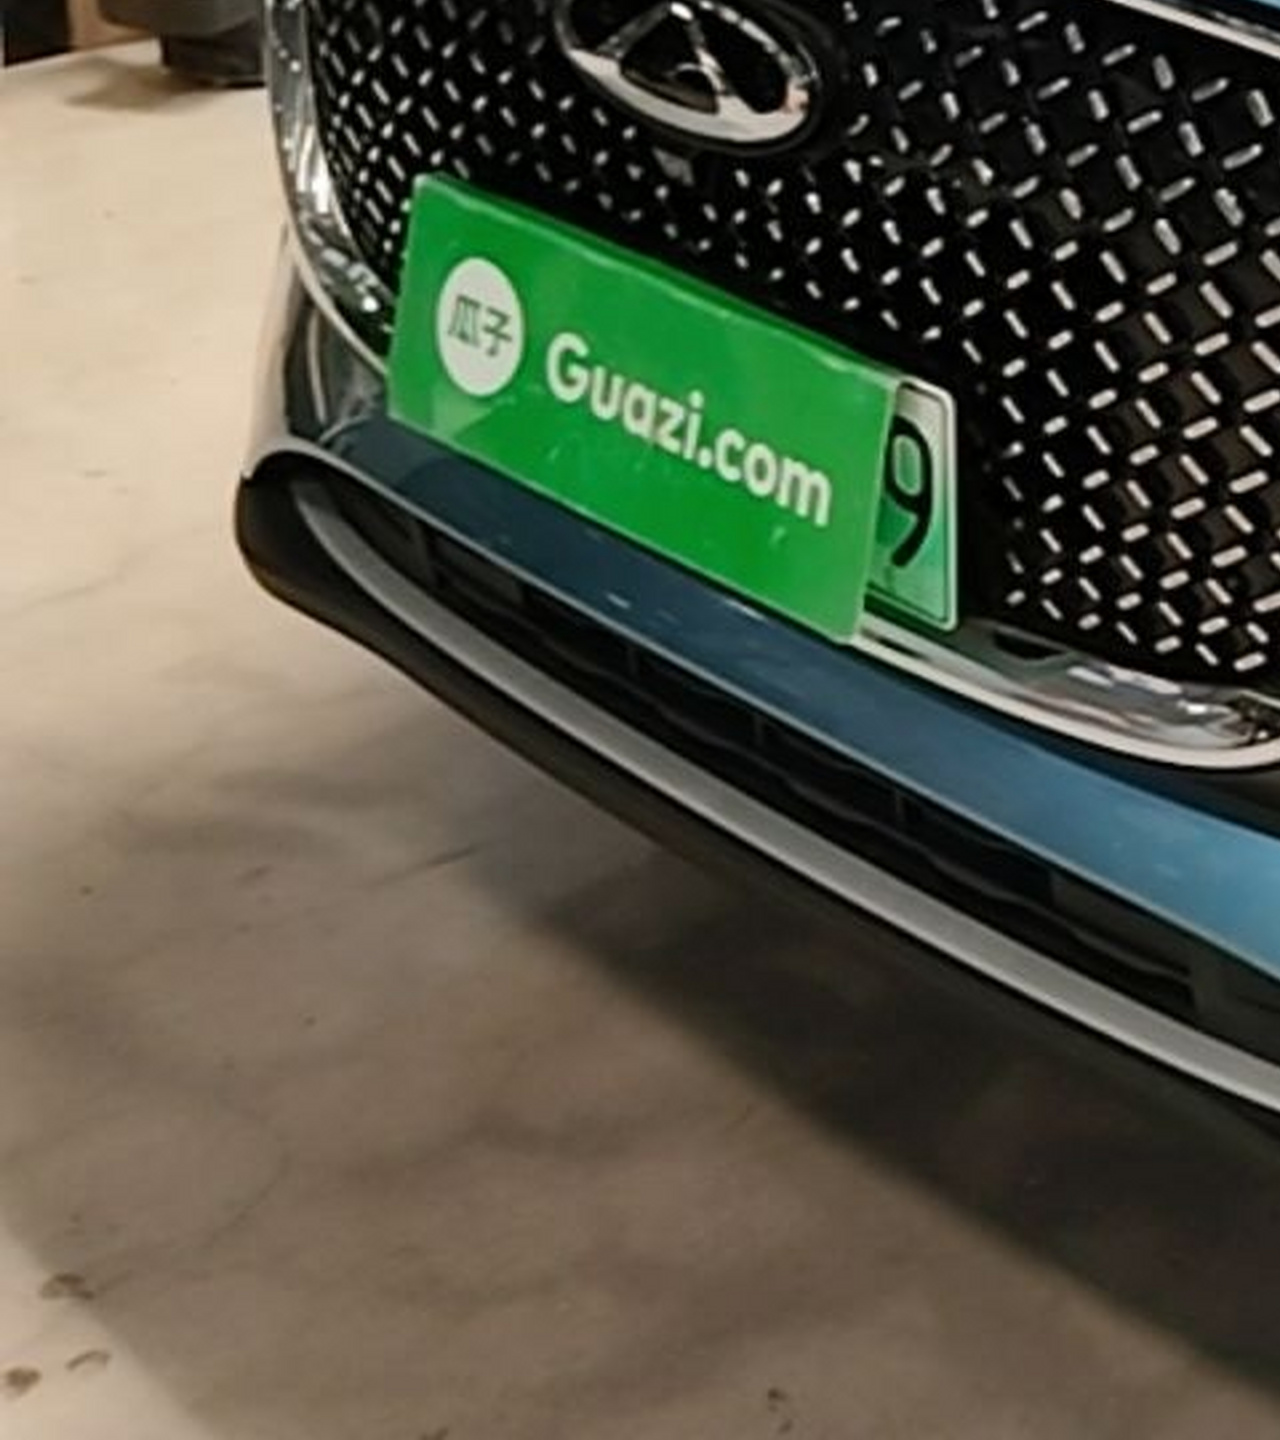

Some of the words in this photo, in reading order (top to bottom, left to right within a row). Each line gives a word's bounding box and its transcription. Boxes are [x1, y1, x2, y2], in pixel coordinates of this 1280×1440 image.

[447, 293, 513, 358] 瓜子
[545, 332, 833, 527] Guazi.com
[883, 414, 935, 567] 9
